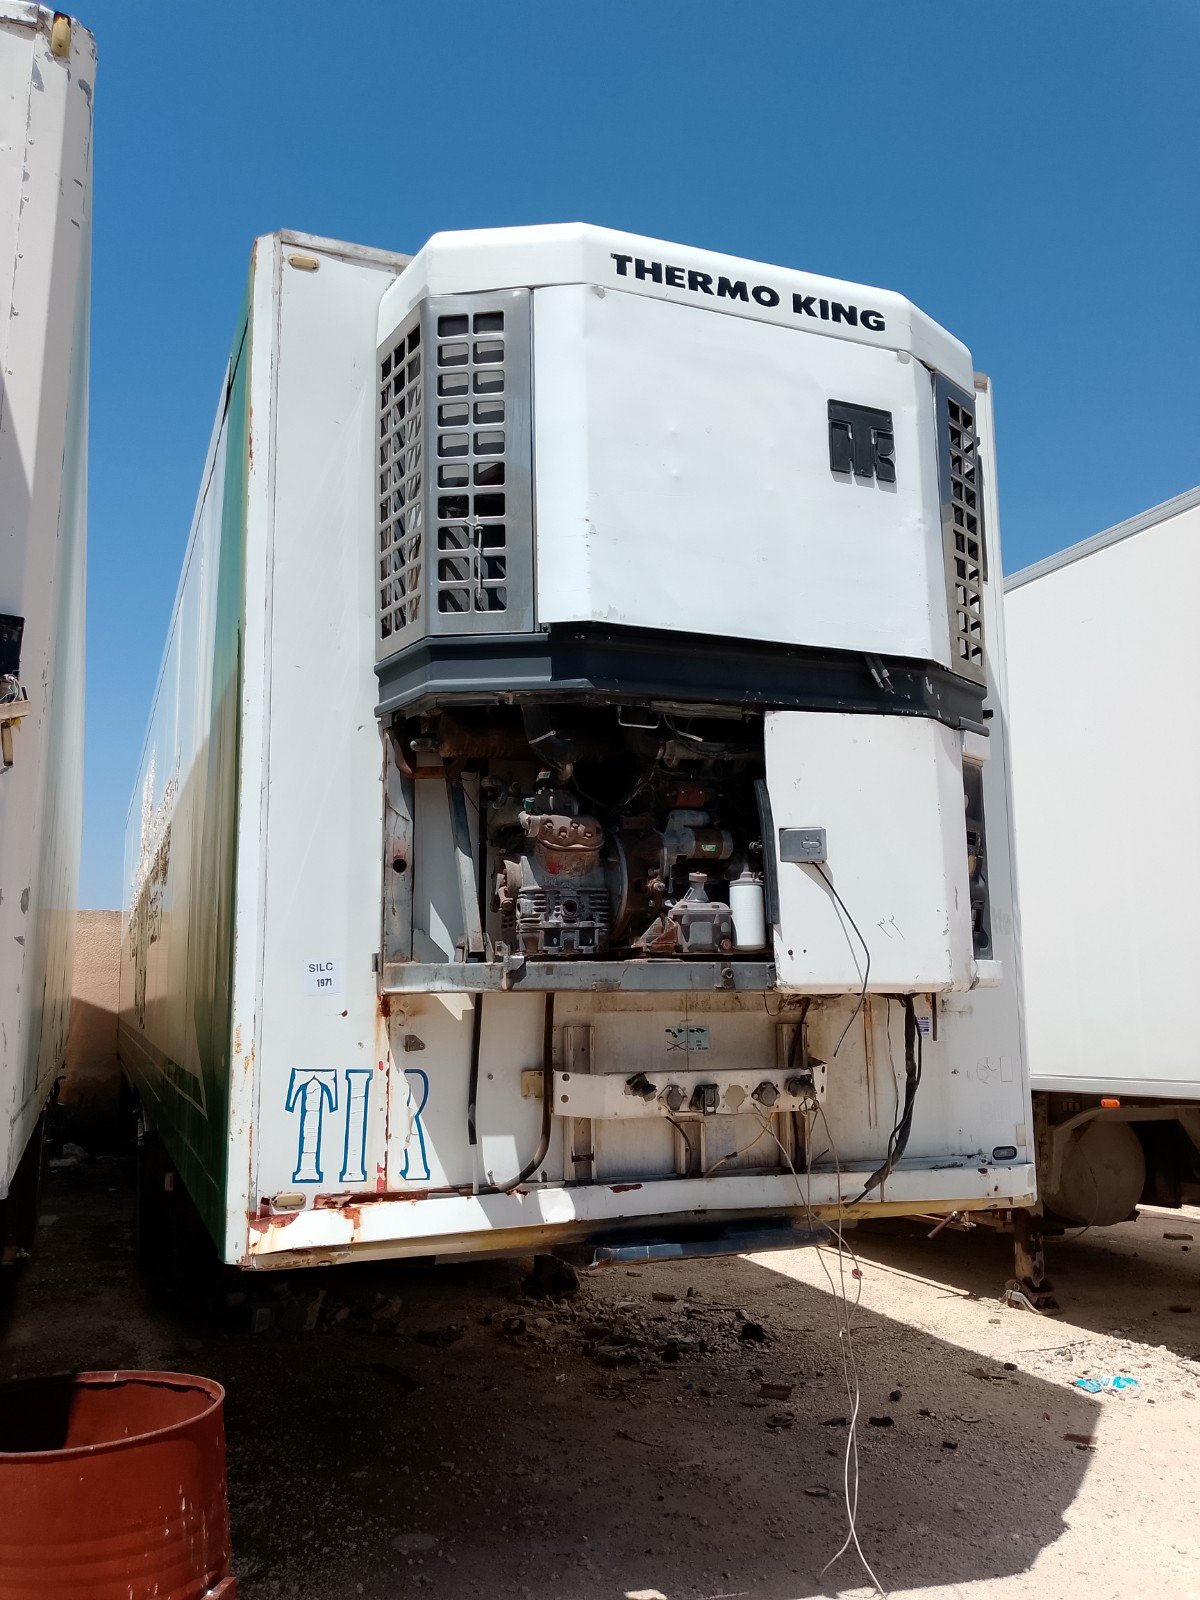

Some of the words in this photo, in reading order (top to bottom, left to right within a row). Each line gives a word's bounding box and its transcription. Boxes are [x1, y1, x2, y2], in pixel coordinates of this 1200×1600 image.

[611, 253, 780, 308] THERMO
[792, 292, 886, 332] KING
[308, 962, 334, 973] SILC
[316, 977, 333, 988] 1971
[285, 1067, 431, 1184] TIR
